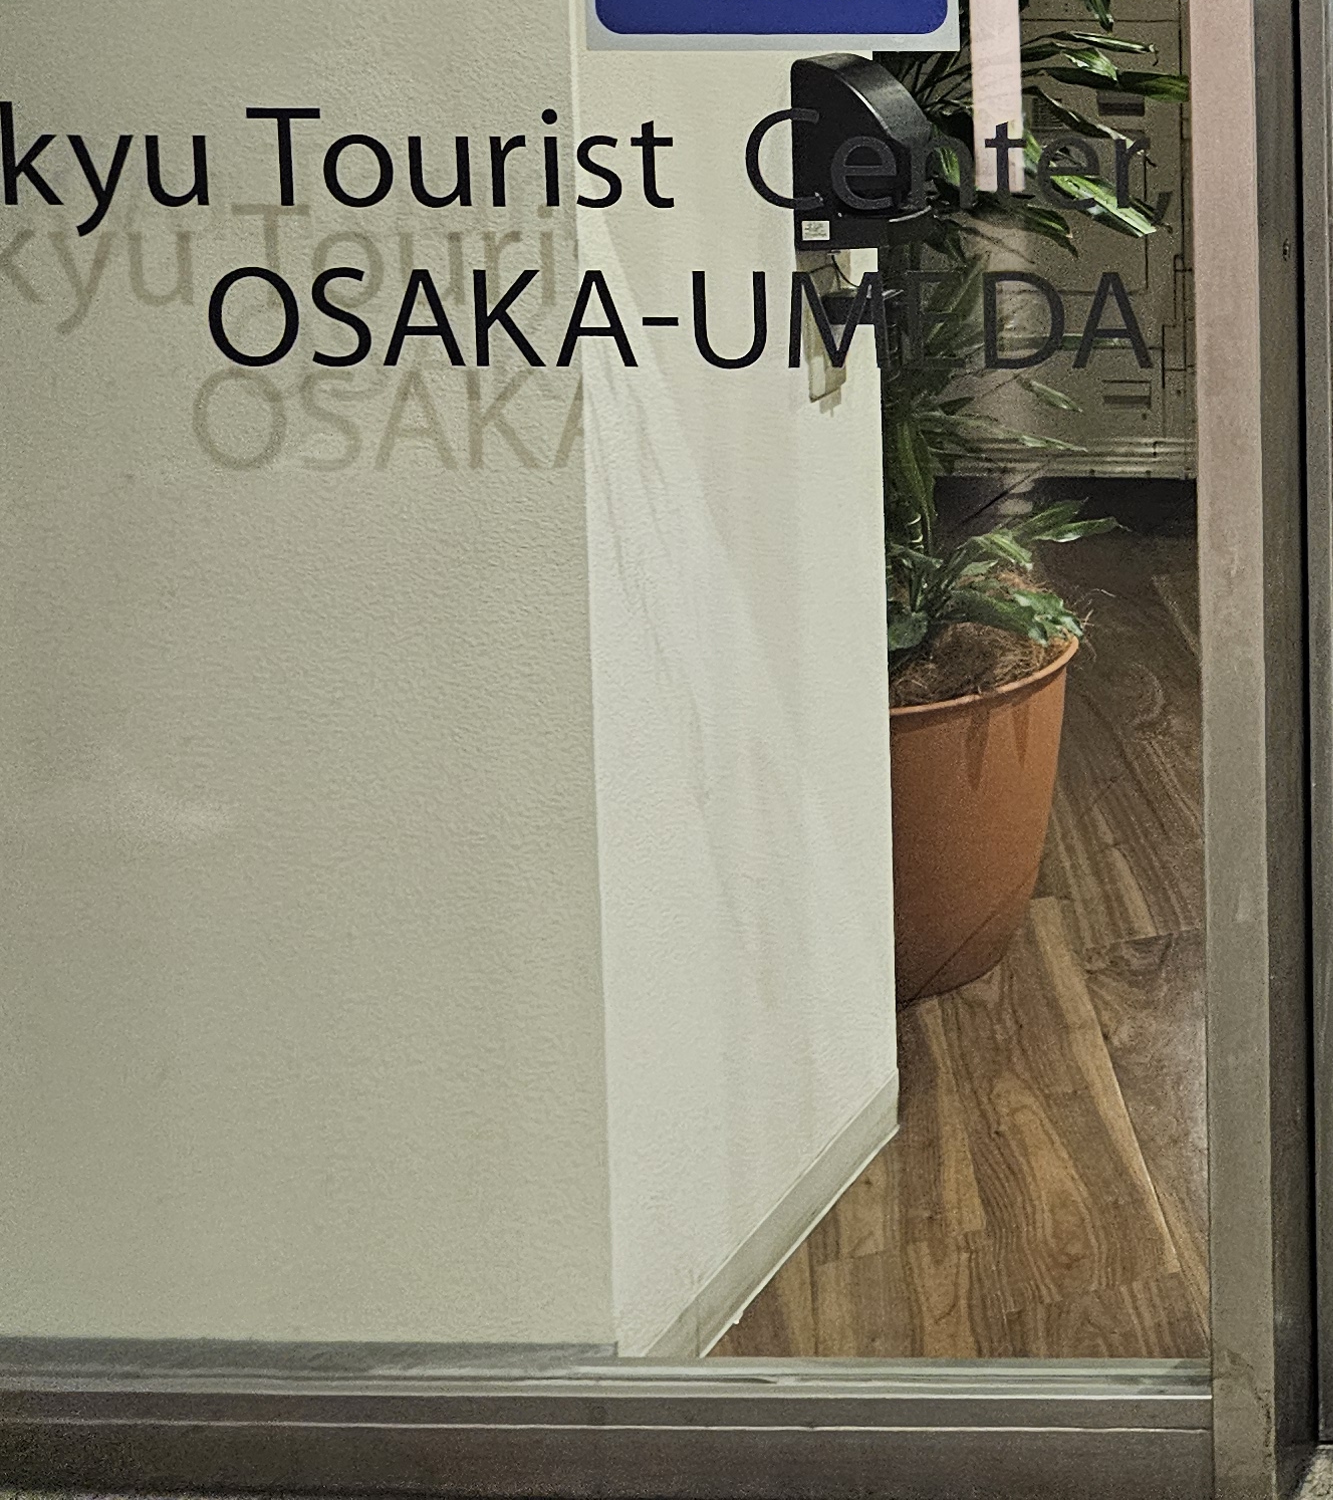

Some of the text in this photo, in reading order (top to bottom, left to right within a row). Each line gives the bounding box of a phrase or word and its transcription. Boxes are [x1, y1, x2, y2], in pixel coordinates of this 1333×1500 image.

[0, 101, 1173, 237] kyu Tourist Center,
[207, 267, 1154, 370] OSAKA-UMEDA
